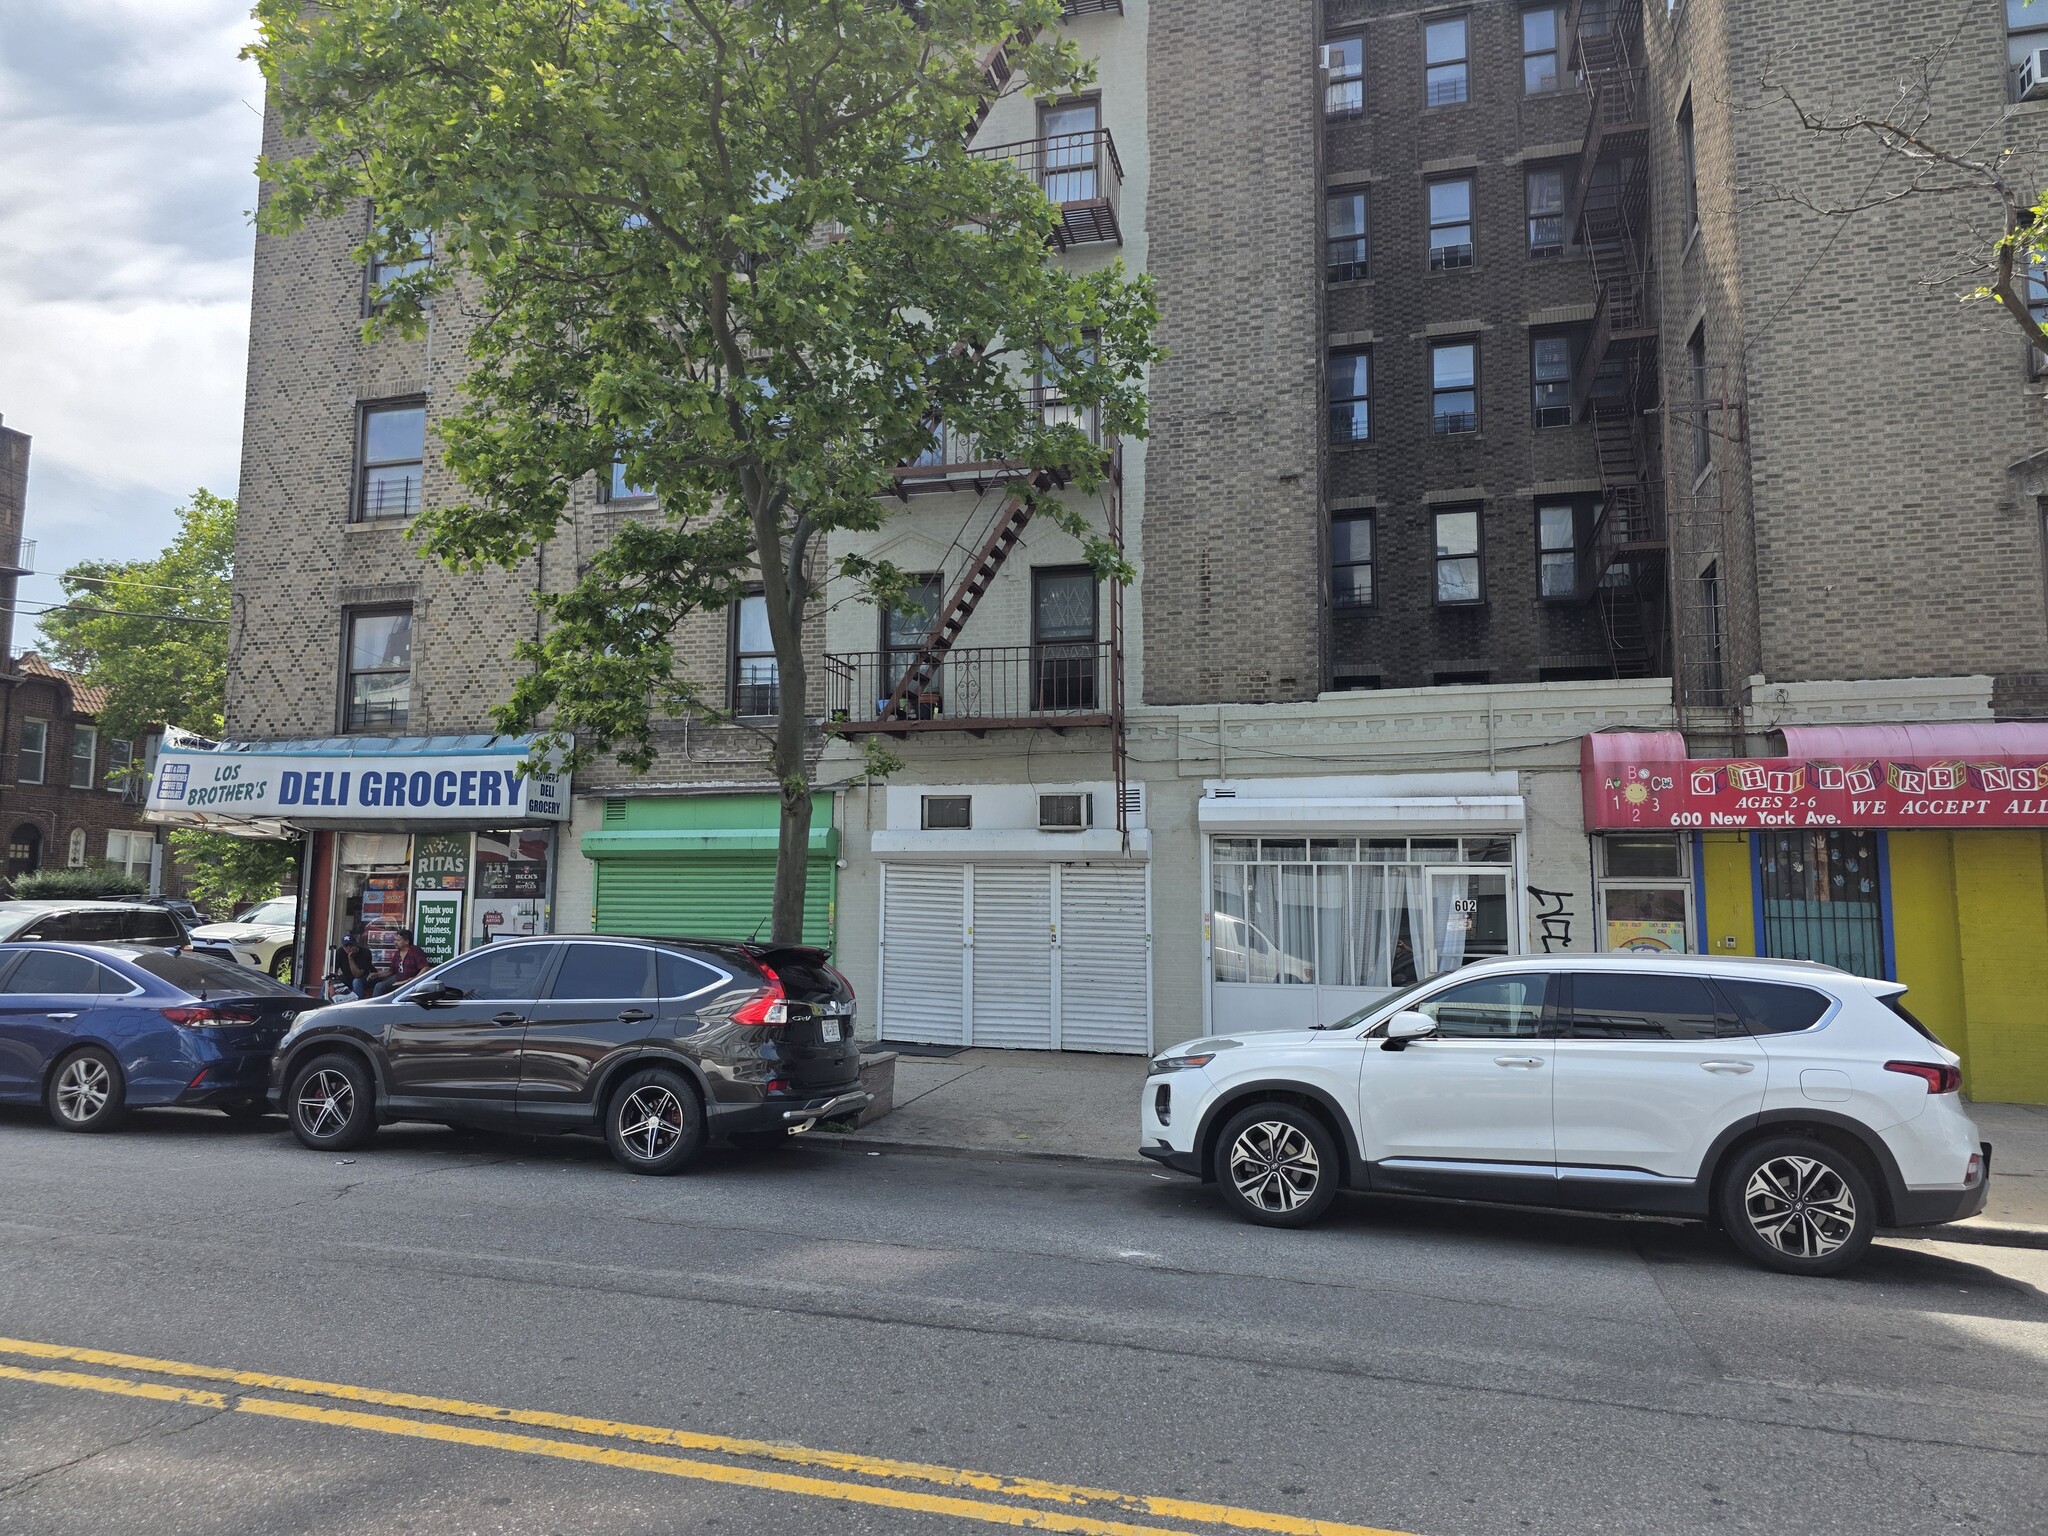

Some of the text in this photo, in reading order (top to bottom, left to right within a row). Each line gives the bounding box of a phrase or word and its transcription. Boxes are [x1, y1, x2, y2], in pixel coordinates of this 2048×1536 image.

[214, 764, 242, 781] LOS
[532, 772, 560, 784] ROTHER'S
[1604, 766, 1662, 791] A B C
[187, 781, 267, 805] BROTHER'S
[278, 770, 526, 807] DELI GROCERY
[540, 784, 555, 798] DELI
[529, 799, 561, 815] GROCERY
[1613, 795, 1660, 822] 1 2 3
[1735, 796, 1817, 809] AGES 2-6
[1852, 800, 1887, 815] WE
[1899, 800, 1990, 814] ACCEPT
[1670, 811, 1841, 826] 600 New York Ave.
[418, 856, 465, 873] RITAS
[421, 905, 454, 916] Thank you
[1455, 900, 1476, 912] 602
[425, 914, 451, 926] for your
[423, 925, 452, 935] business,
[425, 935, 446, 946] please
[436, 945, 452, 954] back
